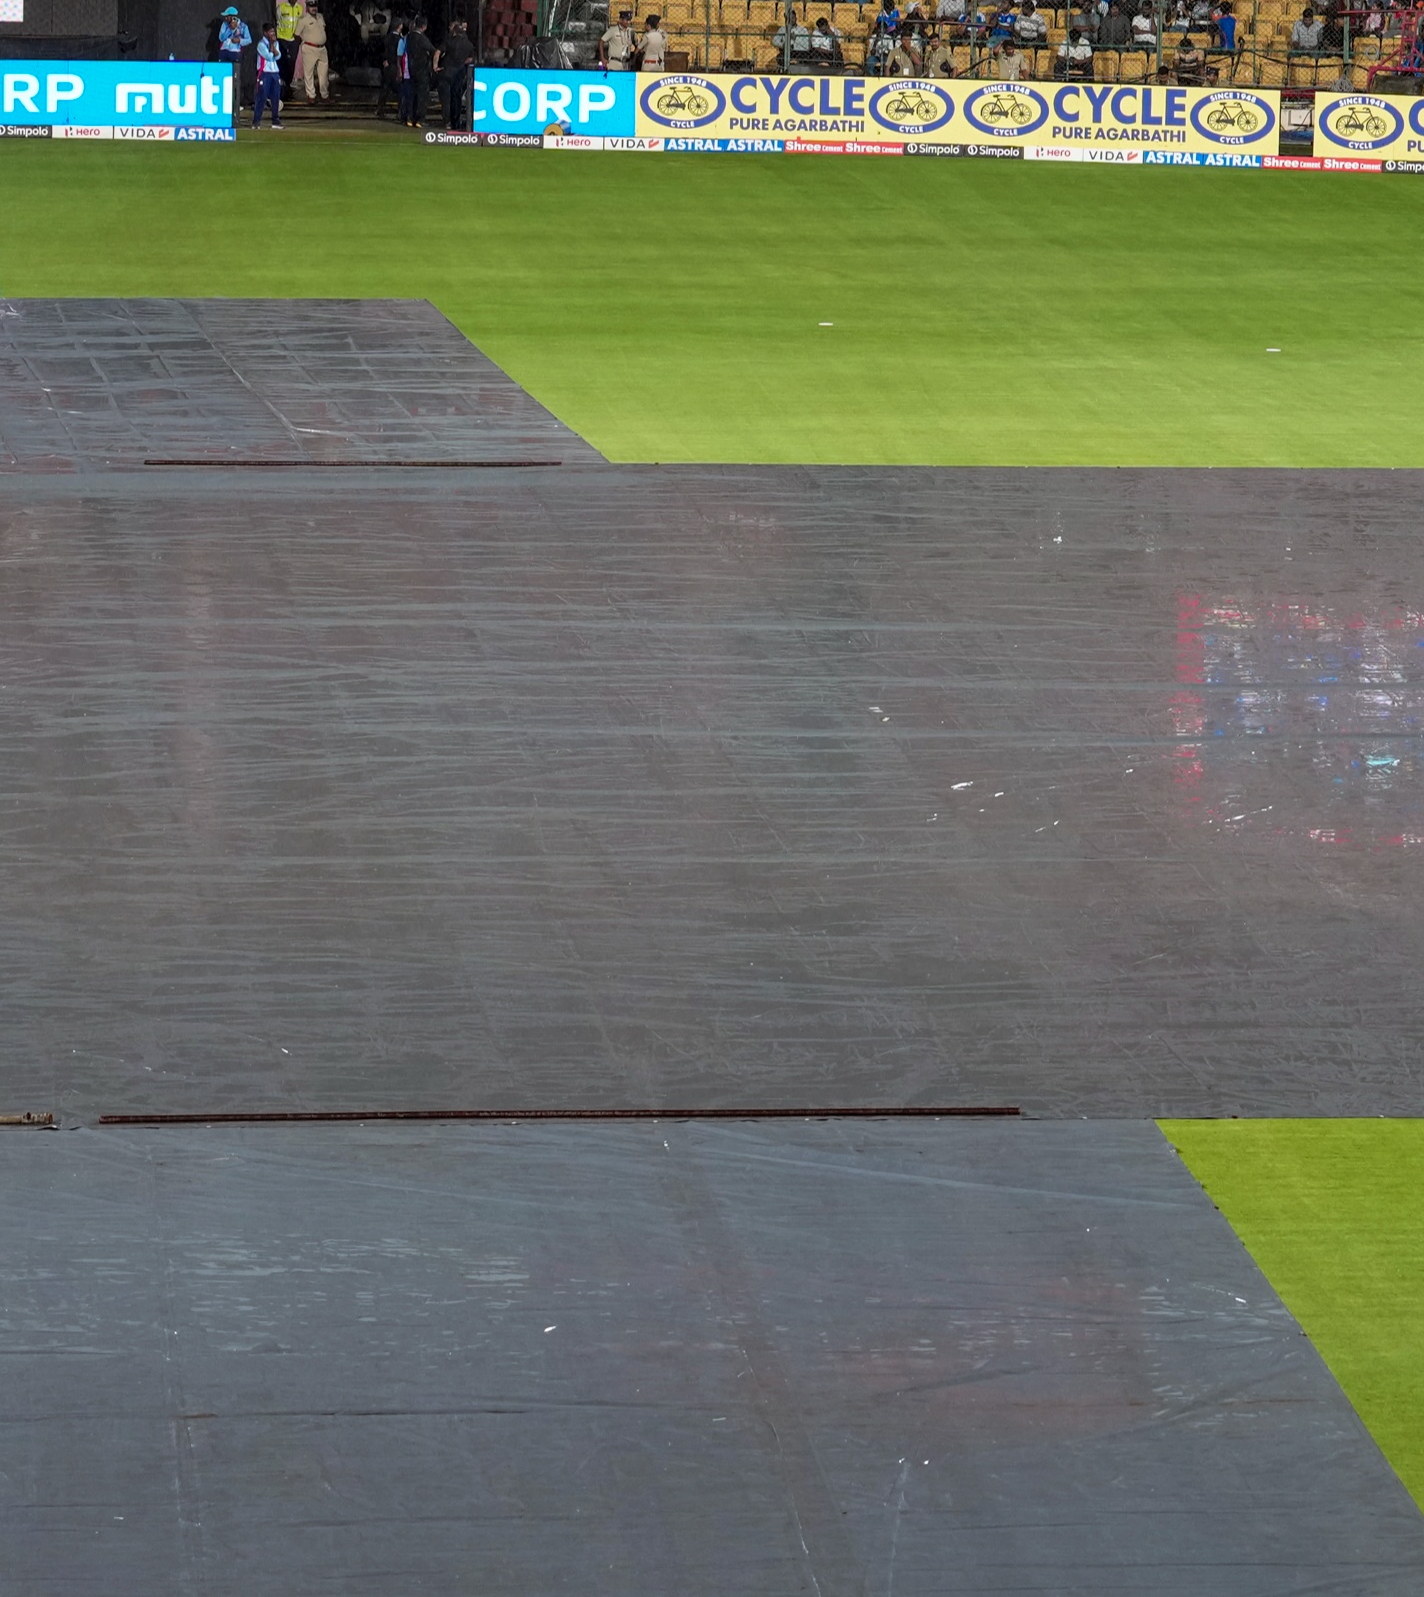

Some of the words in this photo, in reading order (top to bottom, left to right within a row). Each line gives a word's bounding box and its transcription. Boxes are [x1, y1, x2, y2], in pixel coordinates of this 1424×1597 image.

[730, 76, 865, 116] CYCLE
[1339, 97, 1363, 107] SINCE
[1365, 98, 1385, 108] 1948
[671, 120, 695, 128] CYCLE
[437, 133, 478, 145] Simpolo
[1094, 128, 1186, 143] AGARBATHI
[667, 138, 722, 150] ASTRAL
[1089, 151, 1123, 161] VIDA
[1263, 155, 1299, 167] Shree
